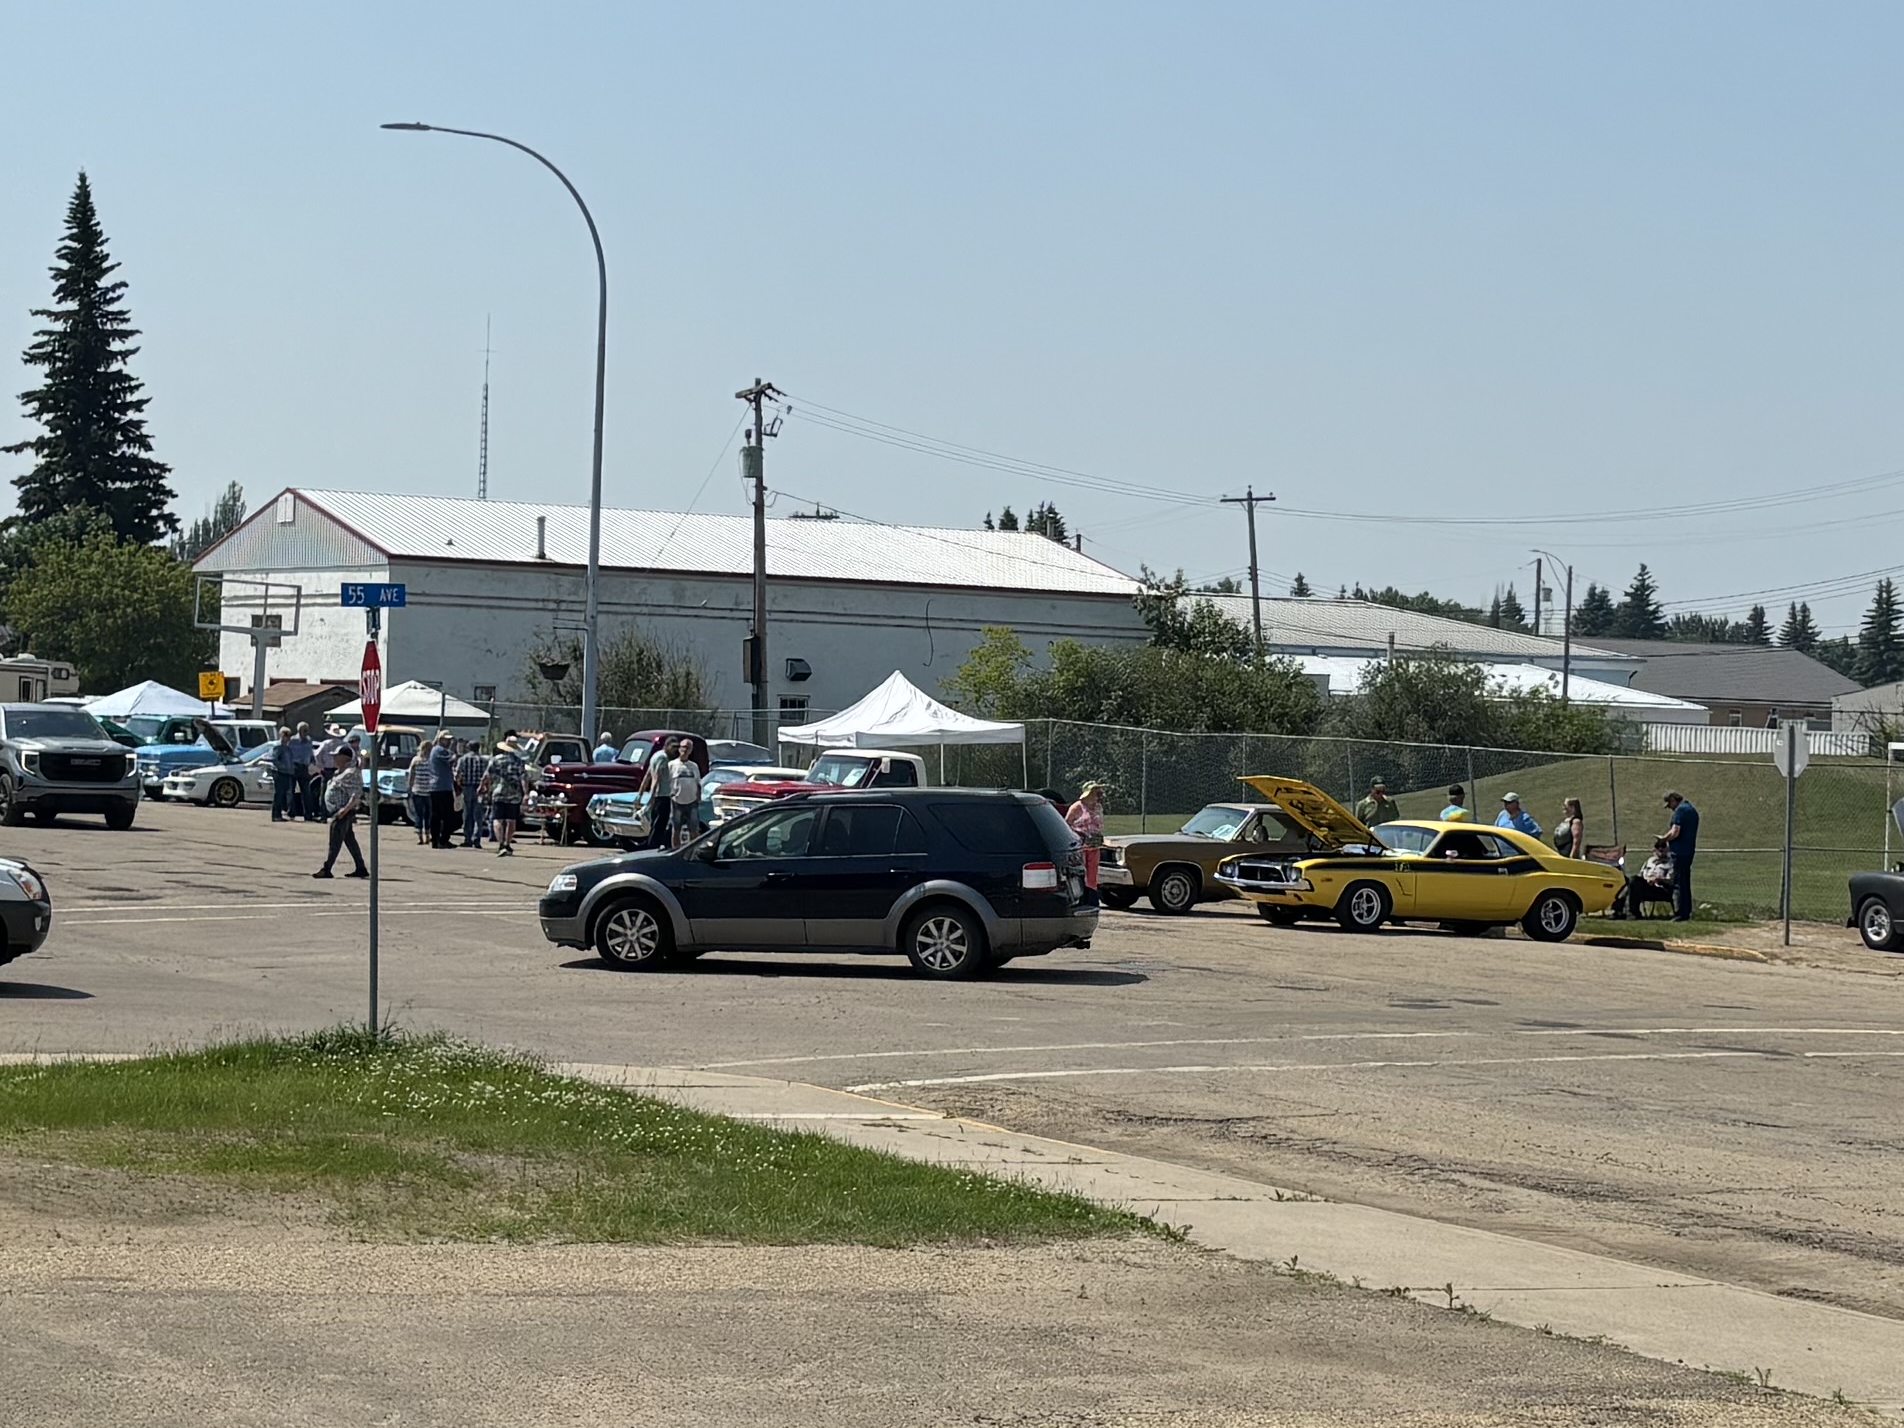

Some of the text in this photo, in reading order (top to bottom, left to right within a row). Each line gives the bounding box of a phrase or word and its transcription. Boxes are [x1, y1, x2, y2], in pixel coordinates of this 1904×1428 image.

[348, 586, 400, 605] 55 AVE
[362, 669, 380, 705] STOP
